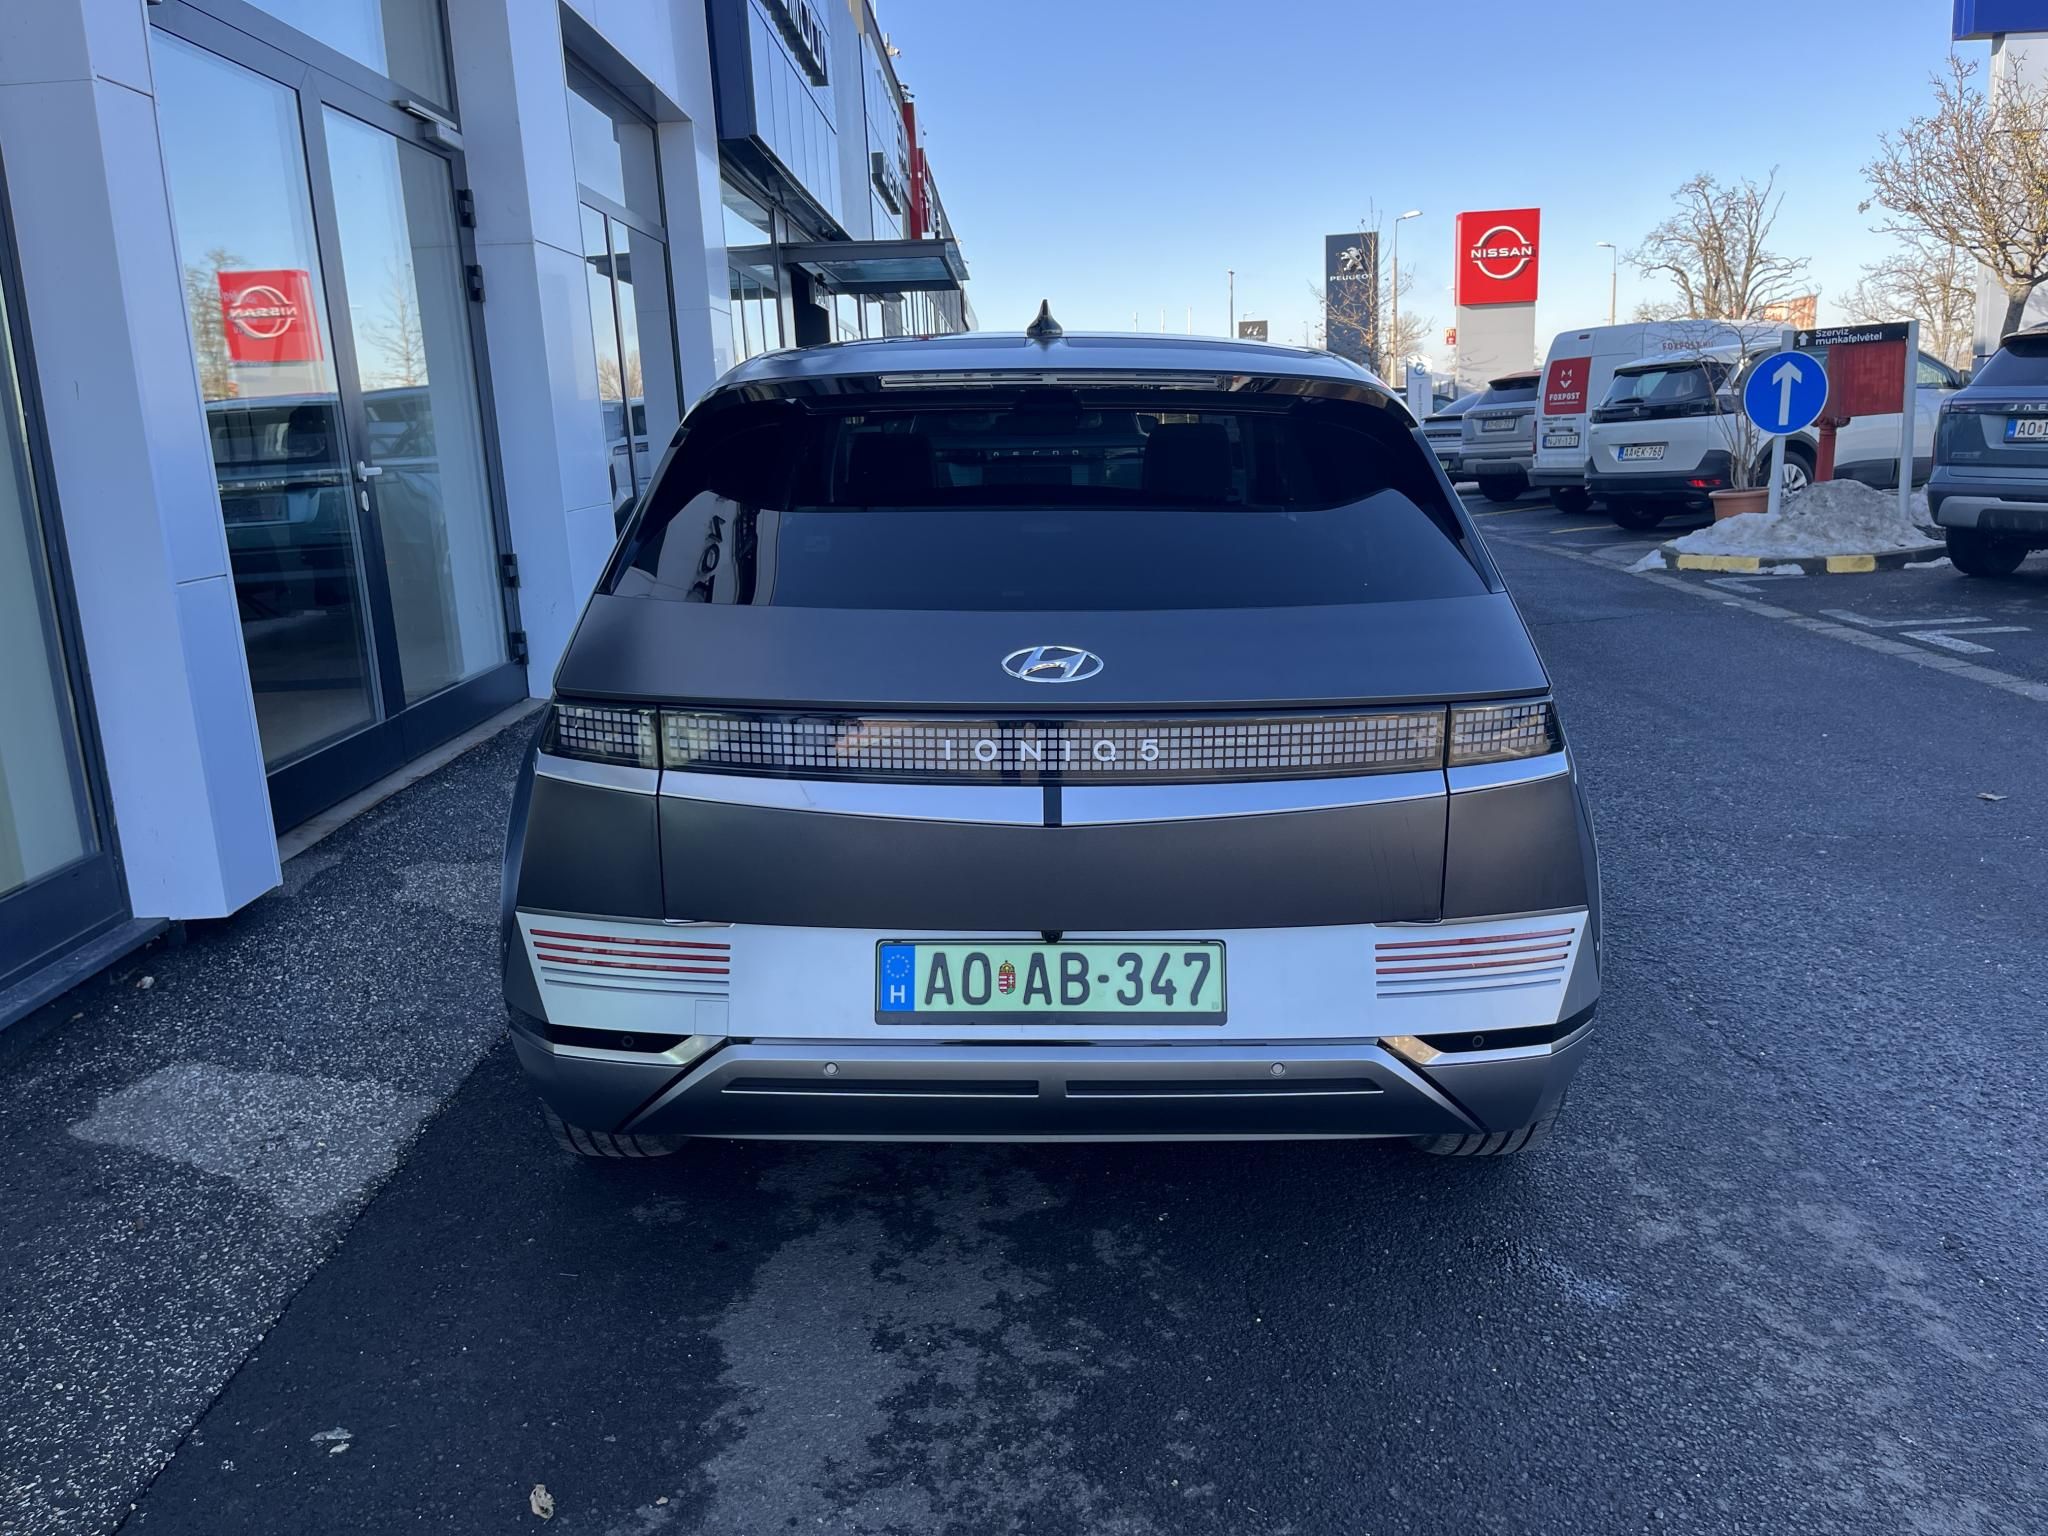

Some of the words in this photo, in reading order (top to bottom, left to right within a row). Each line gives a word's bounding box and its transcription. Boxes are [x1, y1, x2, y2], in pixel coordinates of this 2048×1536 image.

[1471, 246, 1532, 258] NISSAN
[1329, 273, 1374, 282] PEUGEOT
[1816, 327, 1849, 338] Szerviz
[1816, 331, 1883, 346] munkafelvétel
[1549, 392, 1581, 401] FOXPOST
[945, 739, 1116, 762] IONIQ
[1140, 738, 1160, 761] 5
